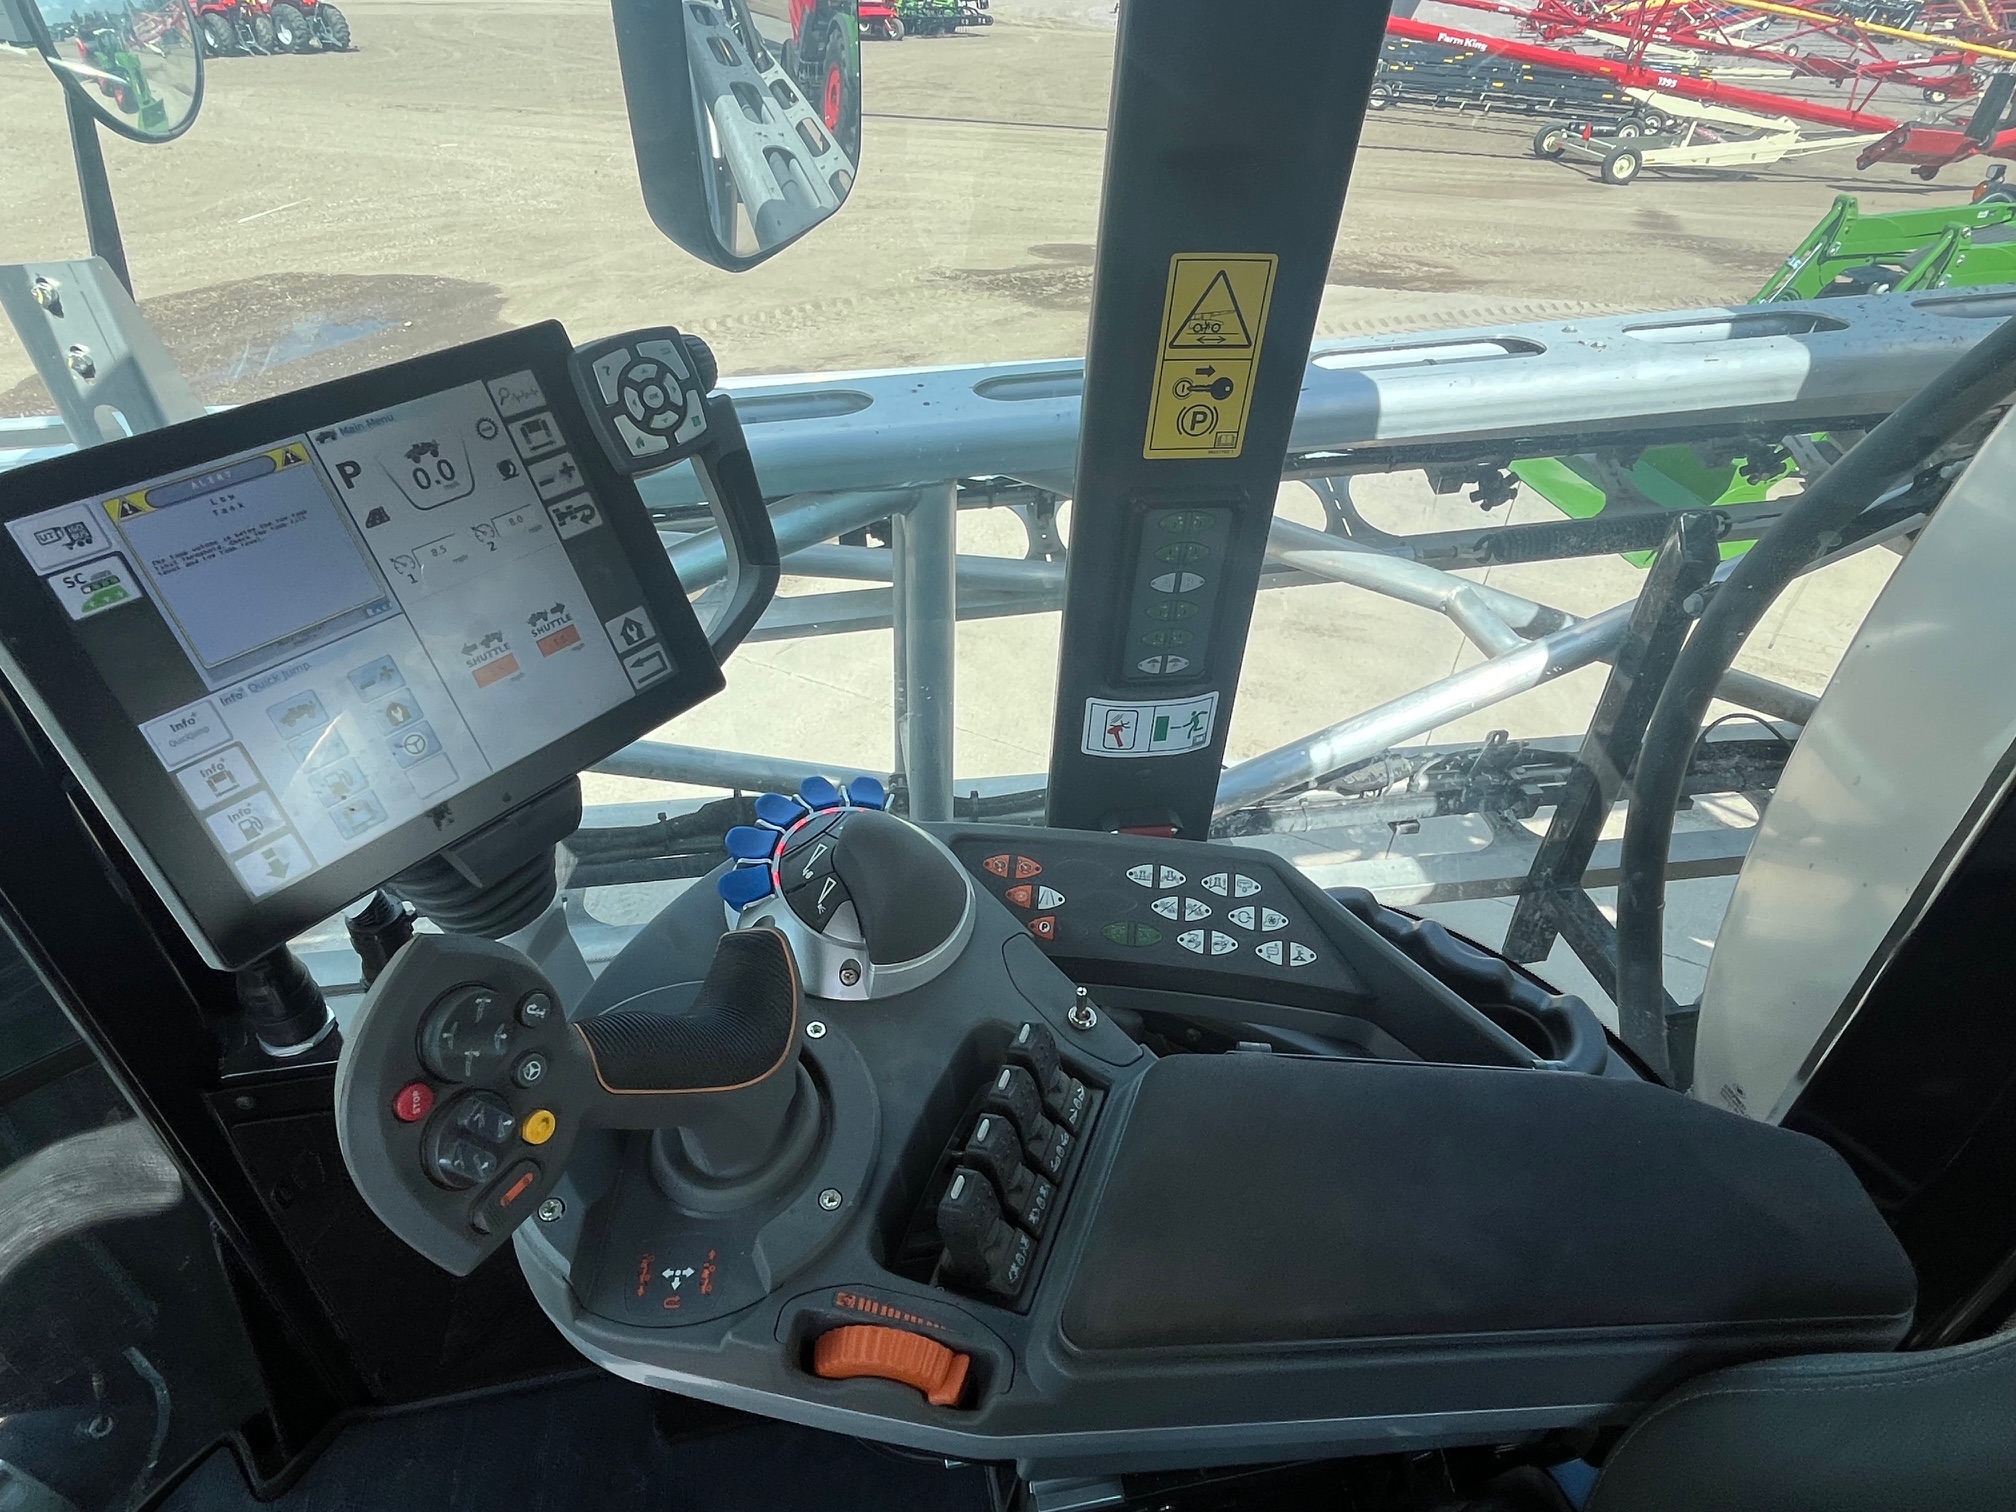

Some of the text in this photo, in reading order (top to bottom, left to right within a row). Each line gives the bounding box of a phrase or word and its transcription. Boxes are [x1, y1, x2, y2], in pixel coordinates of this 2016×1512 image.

[1437, 32, 1488, 52] Farm King
[338, 414, 394, 437] Main Menu
[1190, 411, 1208, 431] P
[335, 460, 362, 489] P
[412, 459, 456, 490] 0.0
[486, 541, 497, 551] 2
[62, 572, 87, 588] SC
[407, 573, 418, 584] 1
[531, 613, 573, 638] SHUTTLE
[466, 642, 511, 668] SHUTTLE
[247, 673, 279, 693] Quick
[281, 661, 312, 681] Jump
[412, 1090, 421, 1115] STOP
